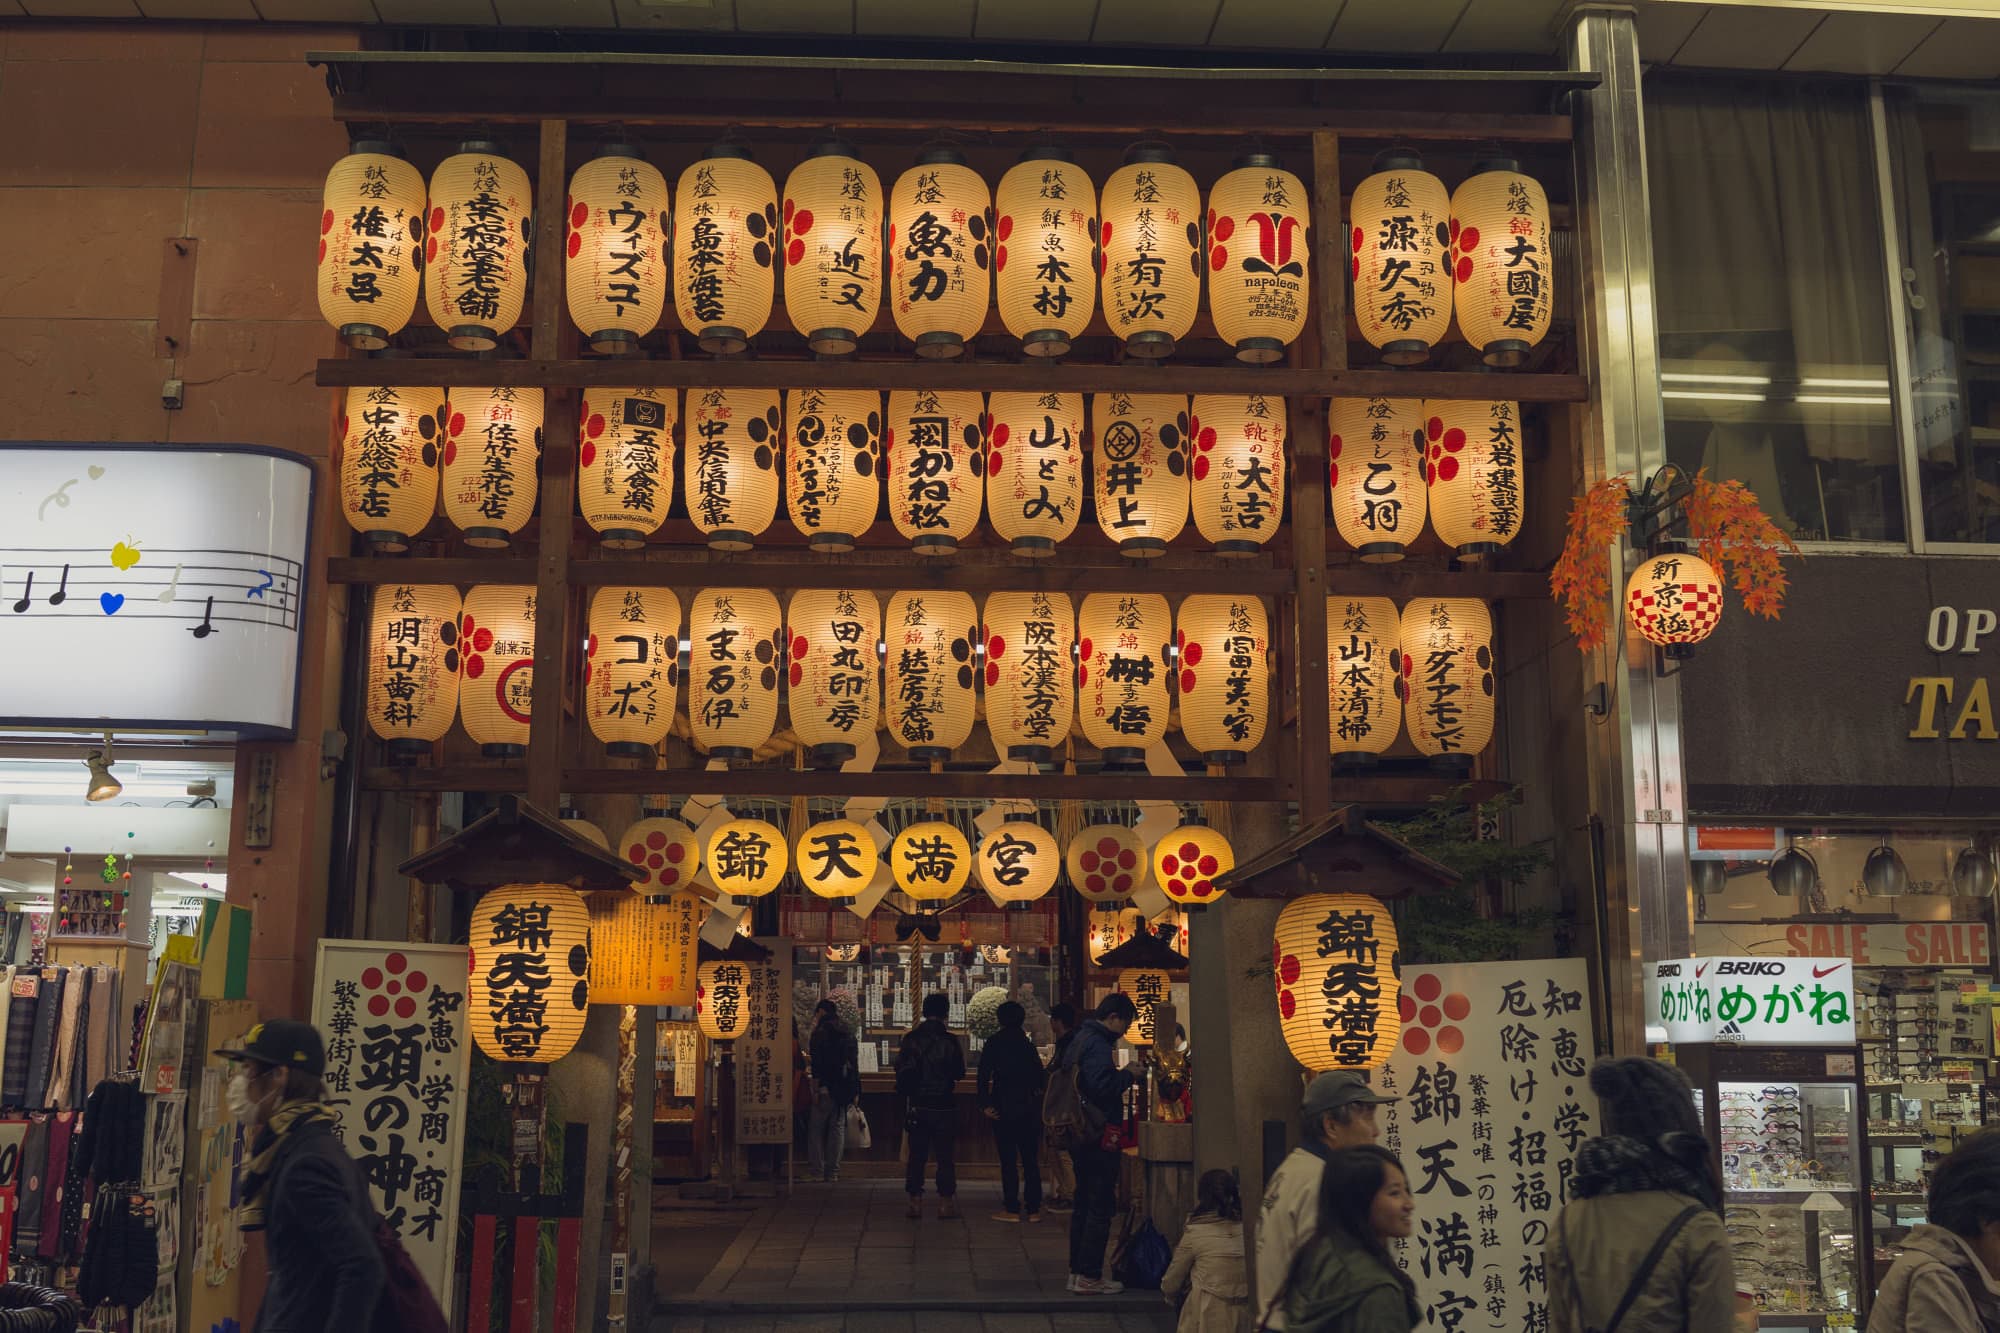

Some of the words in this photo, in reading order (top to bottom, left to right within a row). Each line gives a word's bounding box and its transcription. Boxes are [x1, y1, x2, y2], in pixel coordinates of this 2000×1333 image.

[345, 205, 389, 304] 権太呂
[385, 208, 405, 277] そば料理
[605, 200, 647, 317] ウィズユー
[904, 211, 952, 302] 魚力
[1041, 207, 1065, 251] 鮮魚
[1508, 217, 1533, 235] 錦
[688, 217, 725, 322] 島本海苔
[831, 237, 869, 313] 近又
[1032, 254, 1073, 318] 木村
[1127, 253, 1167, 320] 有次
[1244, 277, 1300, 291] napoleon
[1379, 215, 1420, 331] 源久秀
[357, 406, 400, 517] 中徳総本店
[622, 429, 661, 513] 五感食楽
[695, 419, 735, 527] 中央信用金庫
[1243, 421, 1268, 454] 靴の
[908, 449, 954, 530] かね松
[1106, 461, 1147, 529] 井上
[1235, 456, 1273, 530] 大吉
[1486, 421, 1518, 536] 大岩建設工業
[1652, 558, 1690, 635] 新京極
[1926, 605, 1997, 654] OP
[383, 617, 422, 728] 明山歯科
[494, 640, 535, 655] 創業元
[701, 628, 740, 730] まる伊
[826, 620, 865, 732] 田丸印房
[1021, 620, 1060, 740] 阪本漢方堂
[1337, 635, 1374, 743] 山本清掃
[1425, 646, 1466, 751] ダイアモンド
[1904, 676, 2000, 740] TA
[715, 830, 771, 882] 錦
[808, 832, 864, 882] 天
[904, 834, 958, 884] 満
[986, 832, 1037, 887] 宮
[486, 901, 553, 1058] 錦天満宮
[1657, 964, 1681, 978] BRIKO
[1715, 961, 1786, 976] BRIKO
[1905, 924, 1986, 964] SALE
[712, 965, 744, 1033] 錦天満宮
[1316, 910, 1380, 1065] 錦天満宮
[1660, 981, 1711, 1024] めがね
[1717, 983, 1851, 1026] めがね
[1409, 1062, 1478, 1333] 錦天満宮
